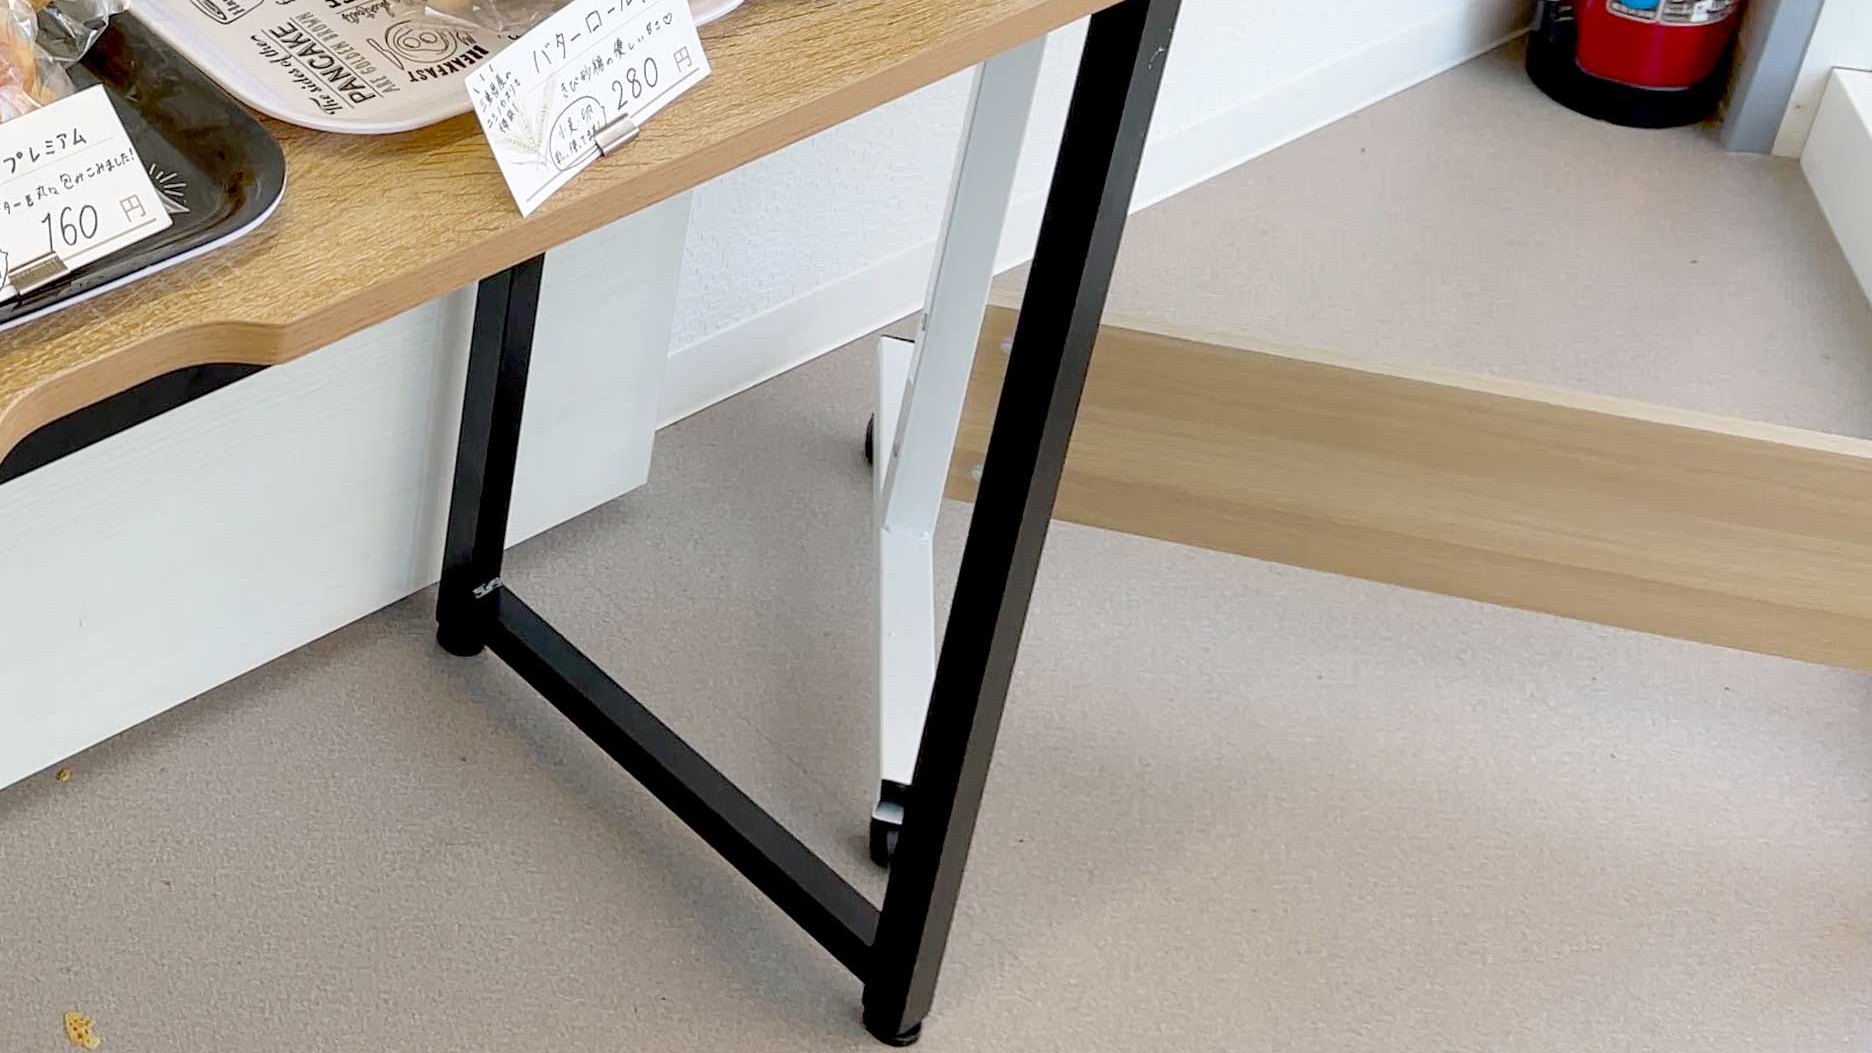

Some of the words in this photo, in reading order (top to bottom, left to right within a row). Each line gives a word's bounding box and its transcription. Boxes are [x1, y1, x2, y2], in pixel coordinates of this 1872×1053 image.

[295, 10, 333, 44] BROWN
[268, 21, 377, 107] PANCAKE
[329, 40, 371, 77] GOLDEN
[407, 43, 490, 83] BREAKFAST
[286, 65, 329, 99] sides
[369, 73, 401, 95] ARE
[611, 57, 659, 110] 280
[673, 46, 693, 73] 円
[41, 204, 98, 252] 160
[119, 194, 147, 223] 円
